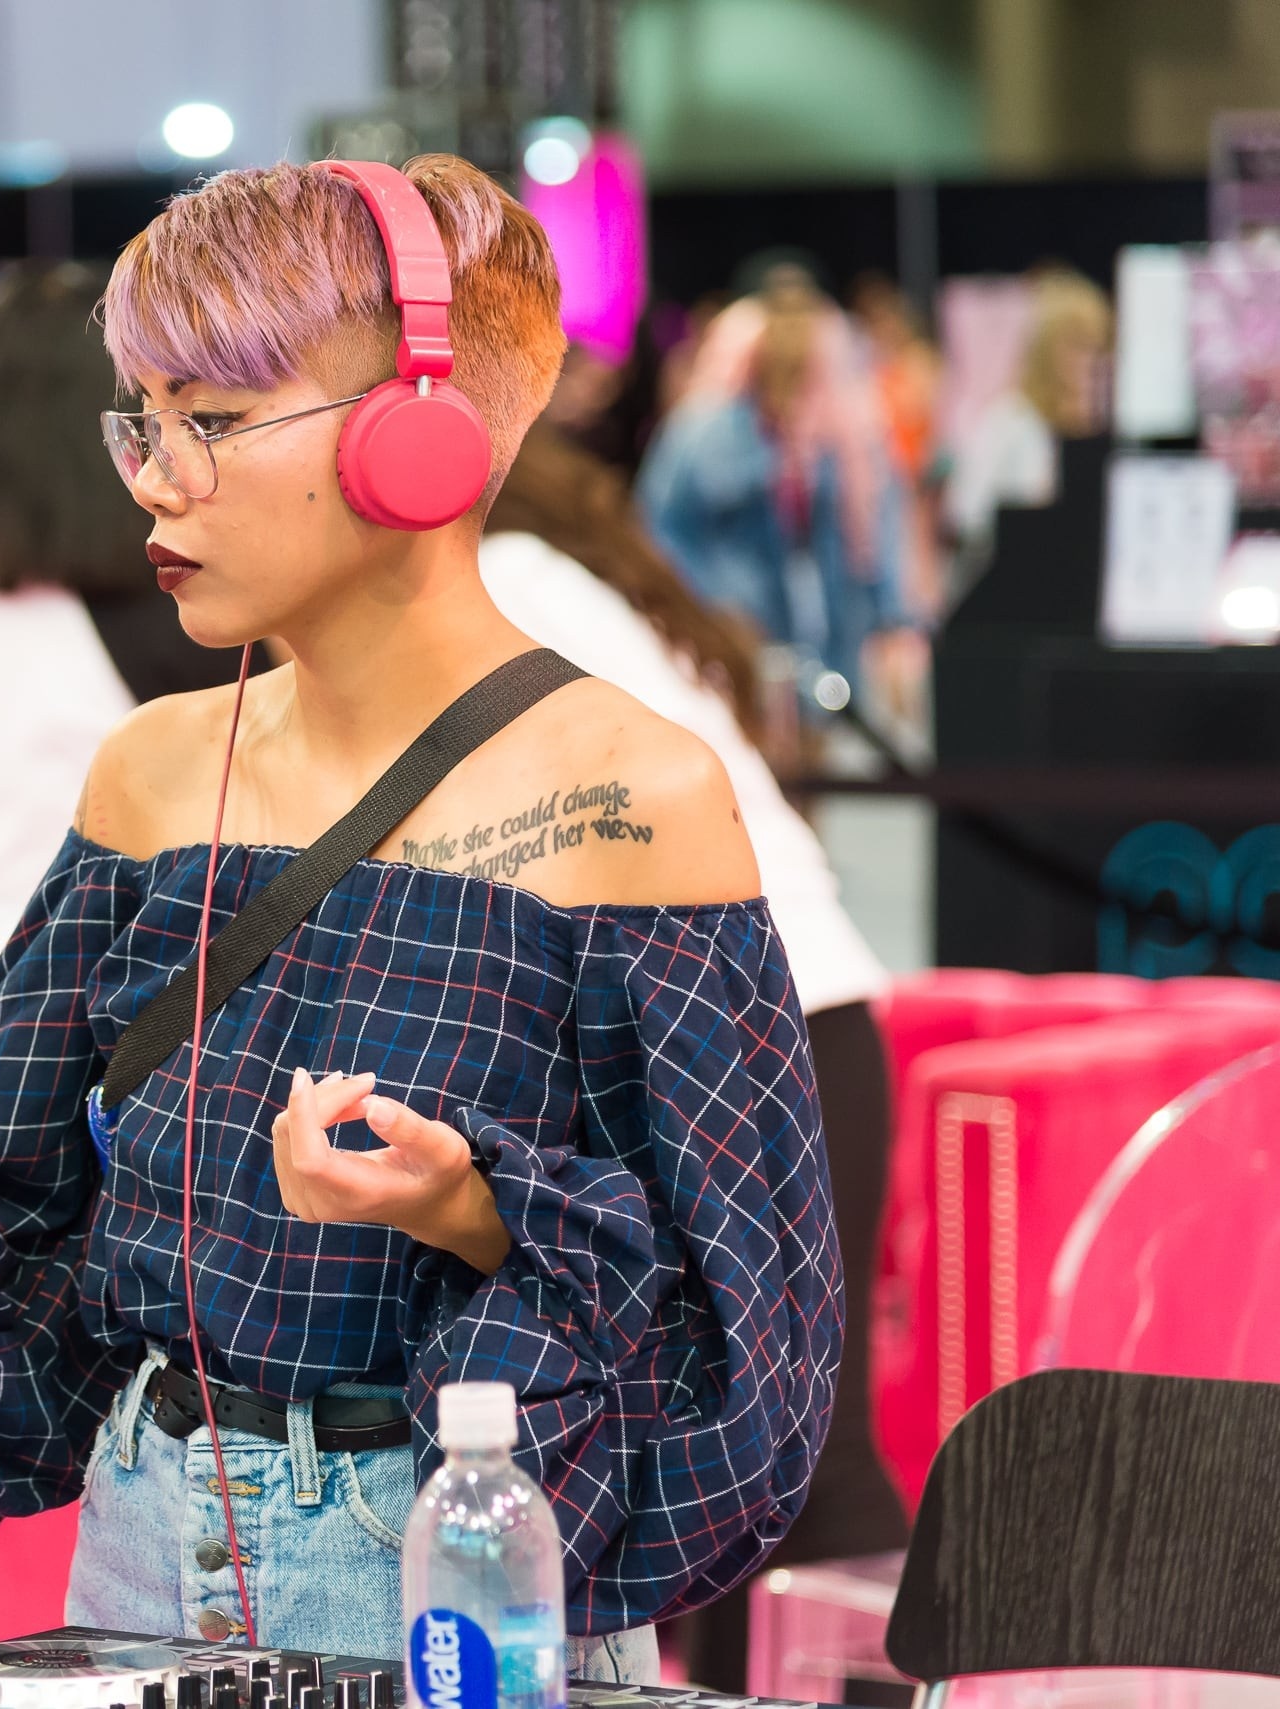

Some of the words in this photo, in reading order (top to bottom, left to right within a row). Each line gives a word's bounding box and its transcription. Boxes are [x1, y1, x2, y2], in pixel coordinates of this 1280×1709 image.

[462, 824, 494, 854] she
[500, 790, 559, 838] could
[563, 780, 631, 816] change
[554, 821, 586, 853] her
[590, 817, 653, 845] view
[422, 1613, 462, 1709] water
